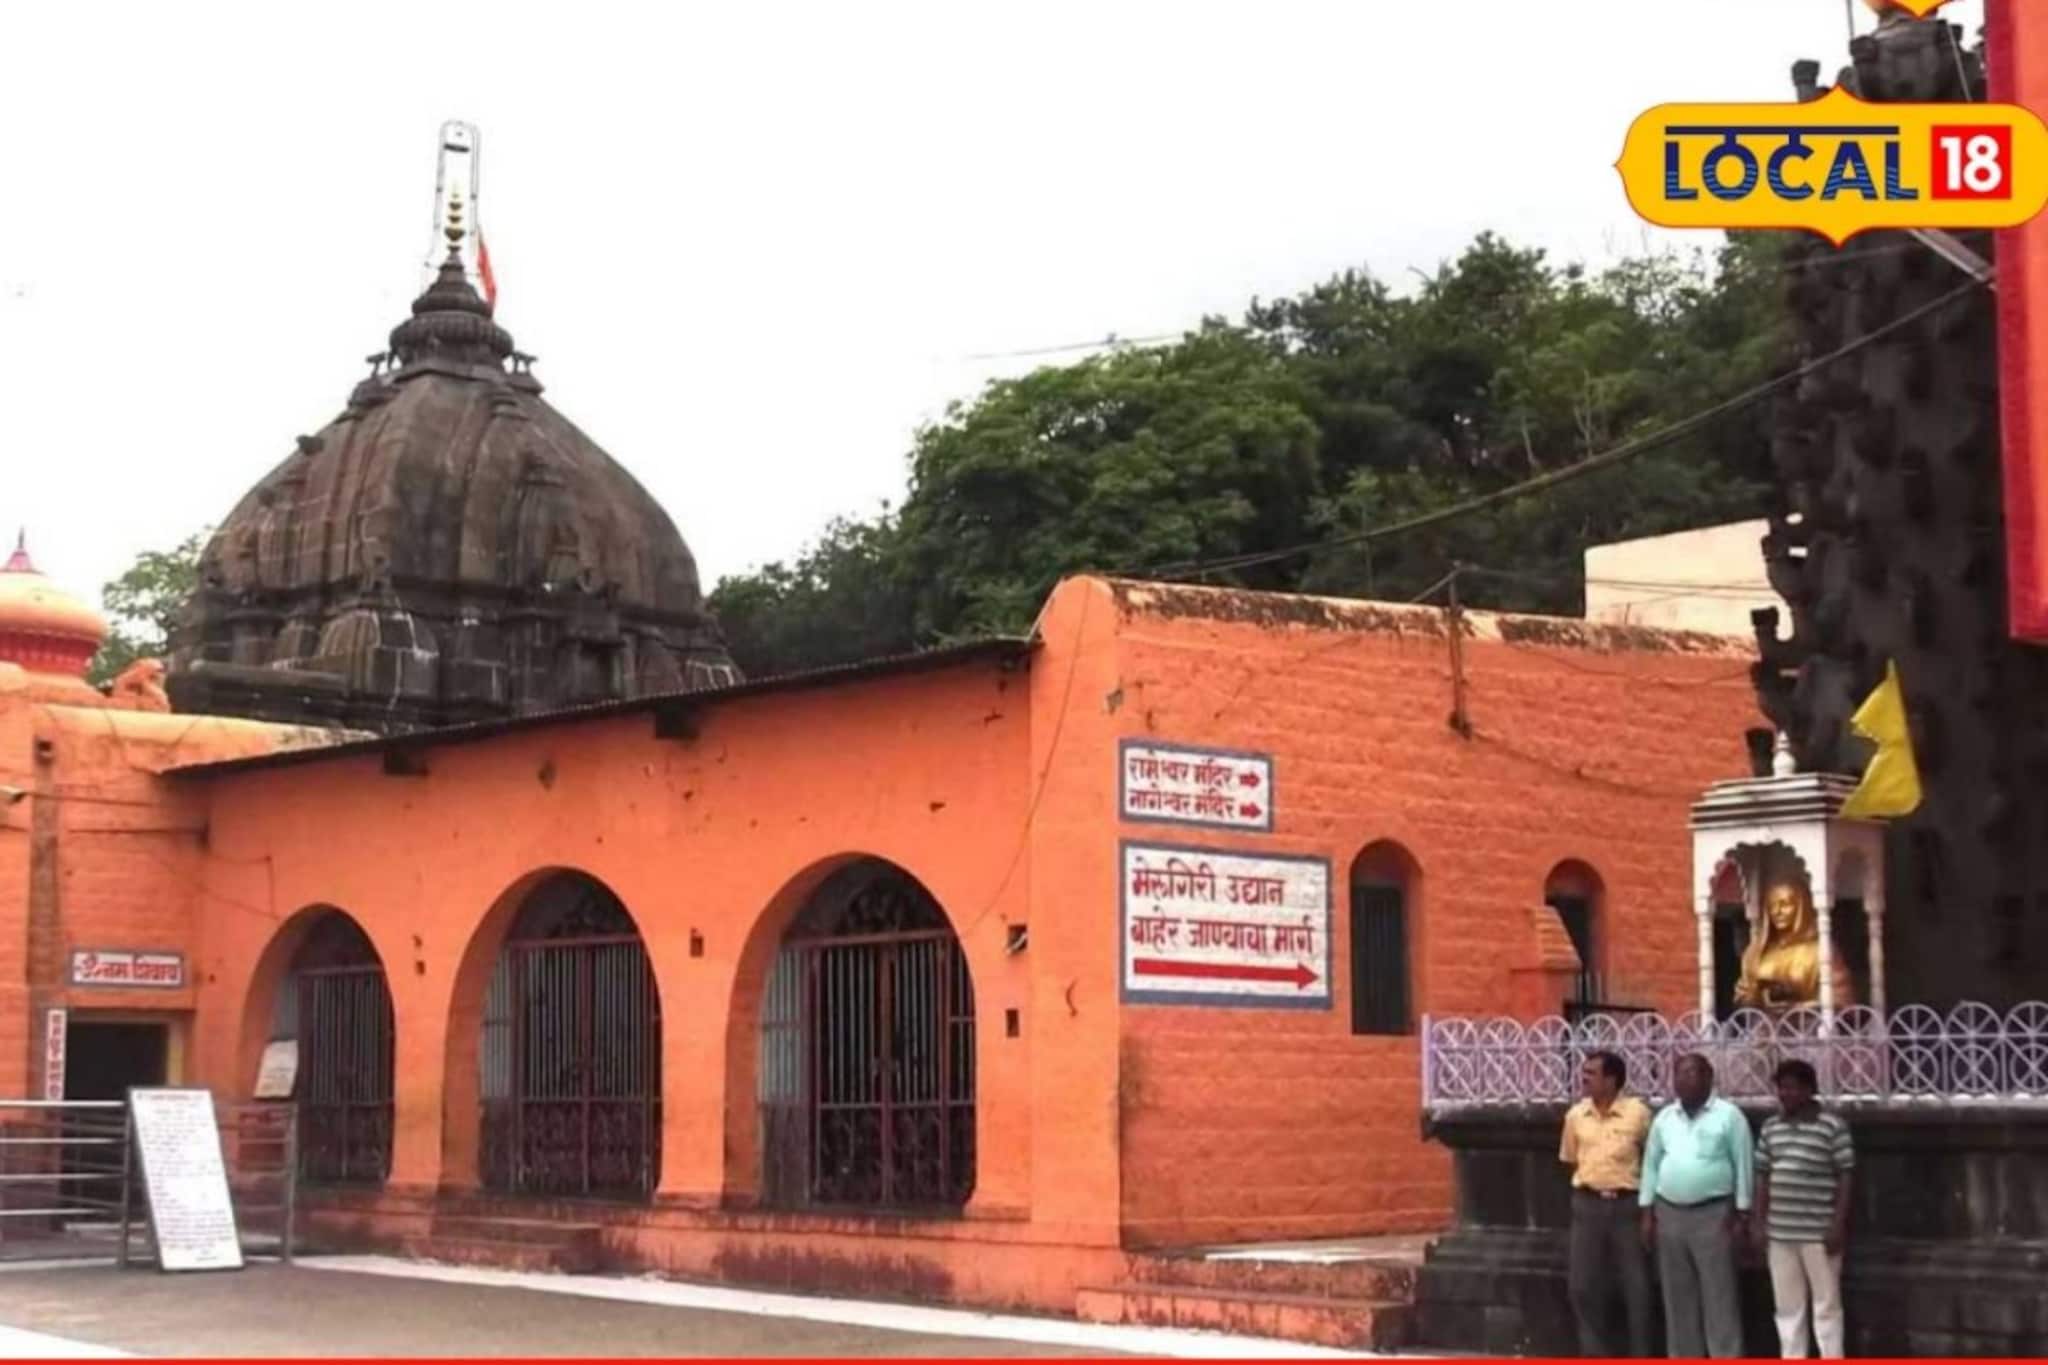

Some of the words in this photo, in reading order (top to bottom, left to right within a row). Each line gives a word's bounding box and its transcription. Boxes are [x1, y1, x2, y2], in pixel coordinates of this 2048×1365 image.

[1193, 758, 1233, 787] मंदिर
[1194, 787, 1235, 818] मंदिर
[1226, 875, 1285, 906] उद्यान
[1130, 905, 1181, 953] बाहेर
[1272, 914, 1315, 954] मार्ग
